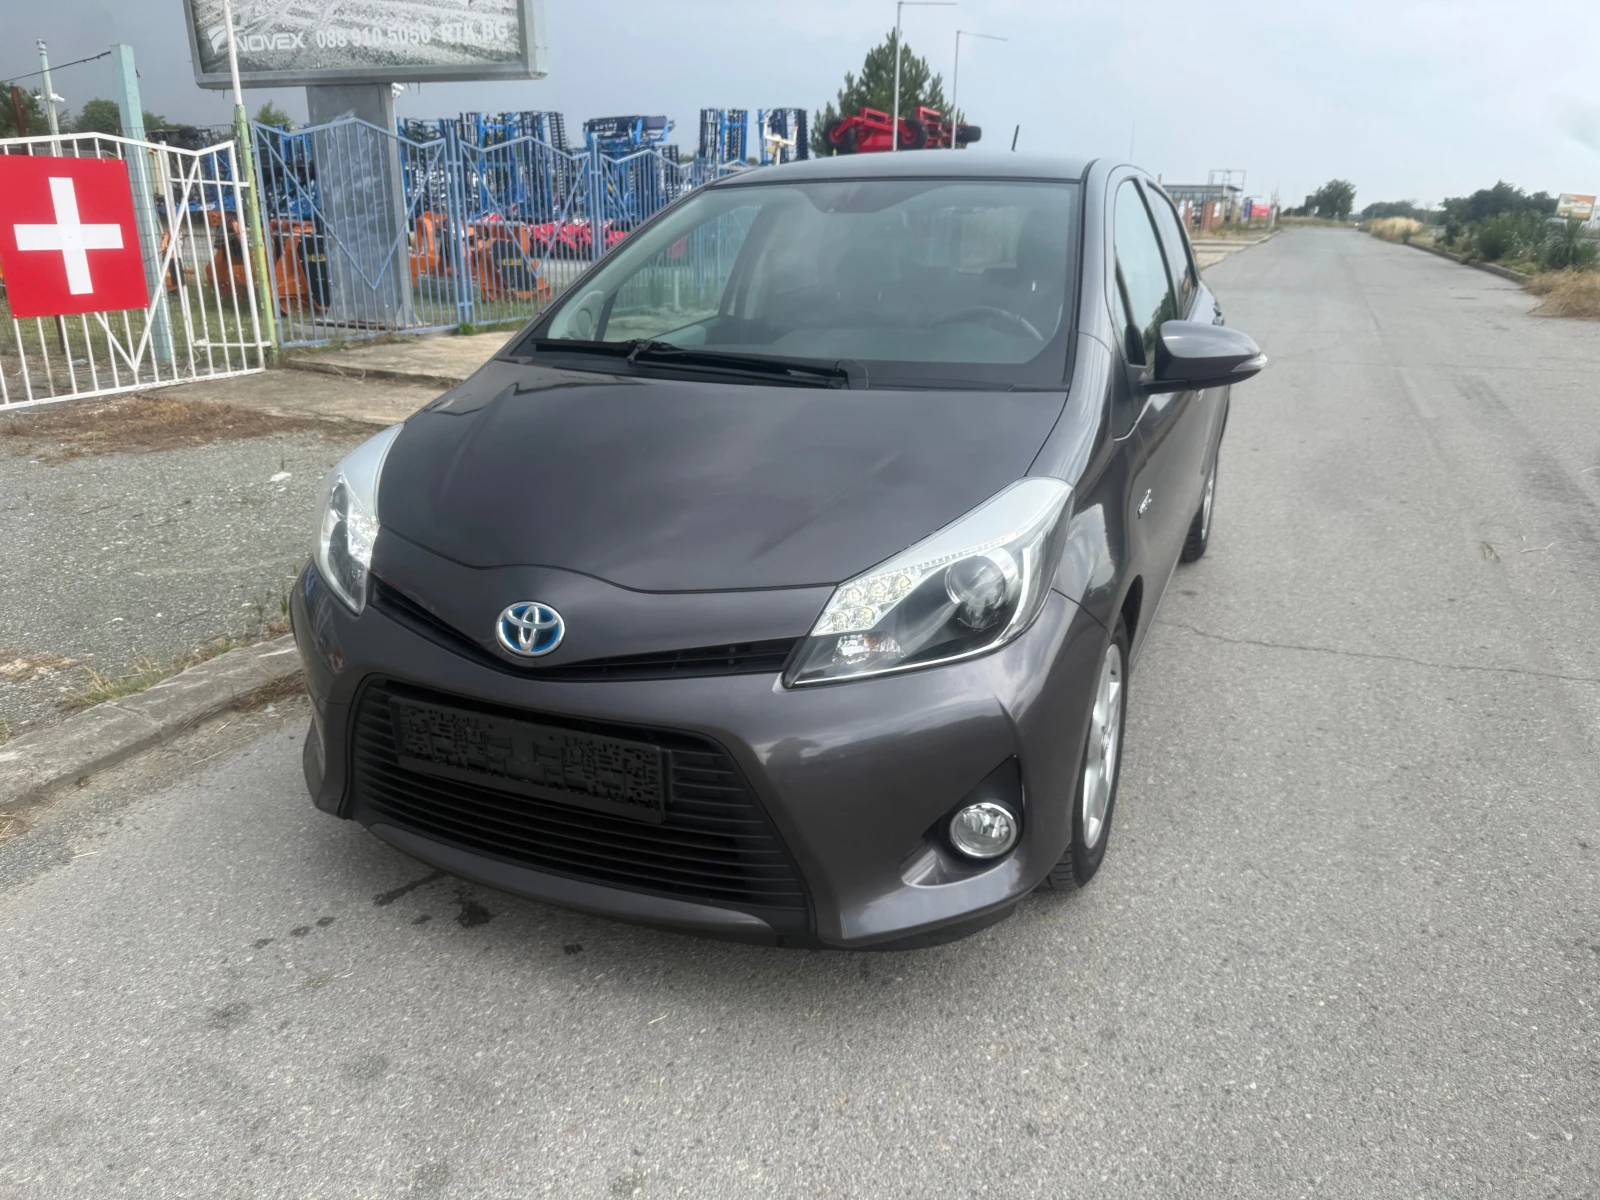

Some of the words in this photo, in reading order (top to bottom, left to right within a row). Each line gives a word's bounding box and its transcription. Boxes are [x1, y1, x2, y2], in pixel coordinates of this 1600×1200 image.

[234, 31, 306, 52] NOVEX
[315, 29, 348, 49] 088
[352, 26, 383, 47] 910
[387, 24, 431, 44] 5050
